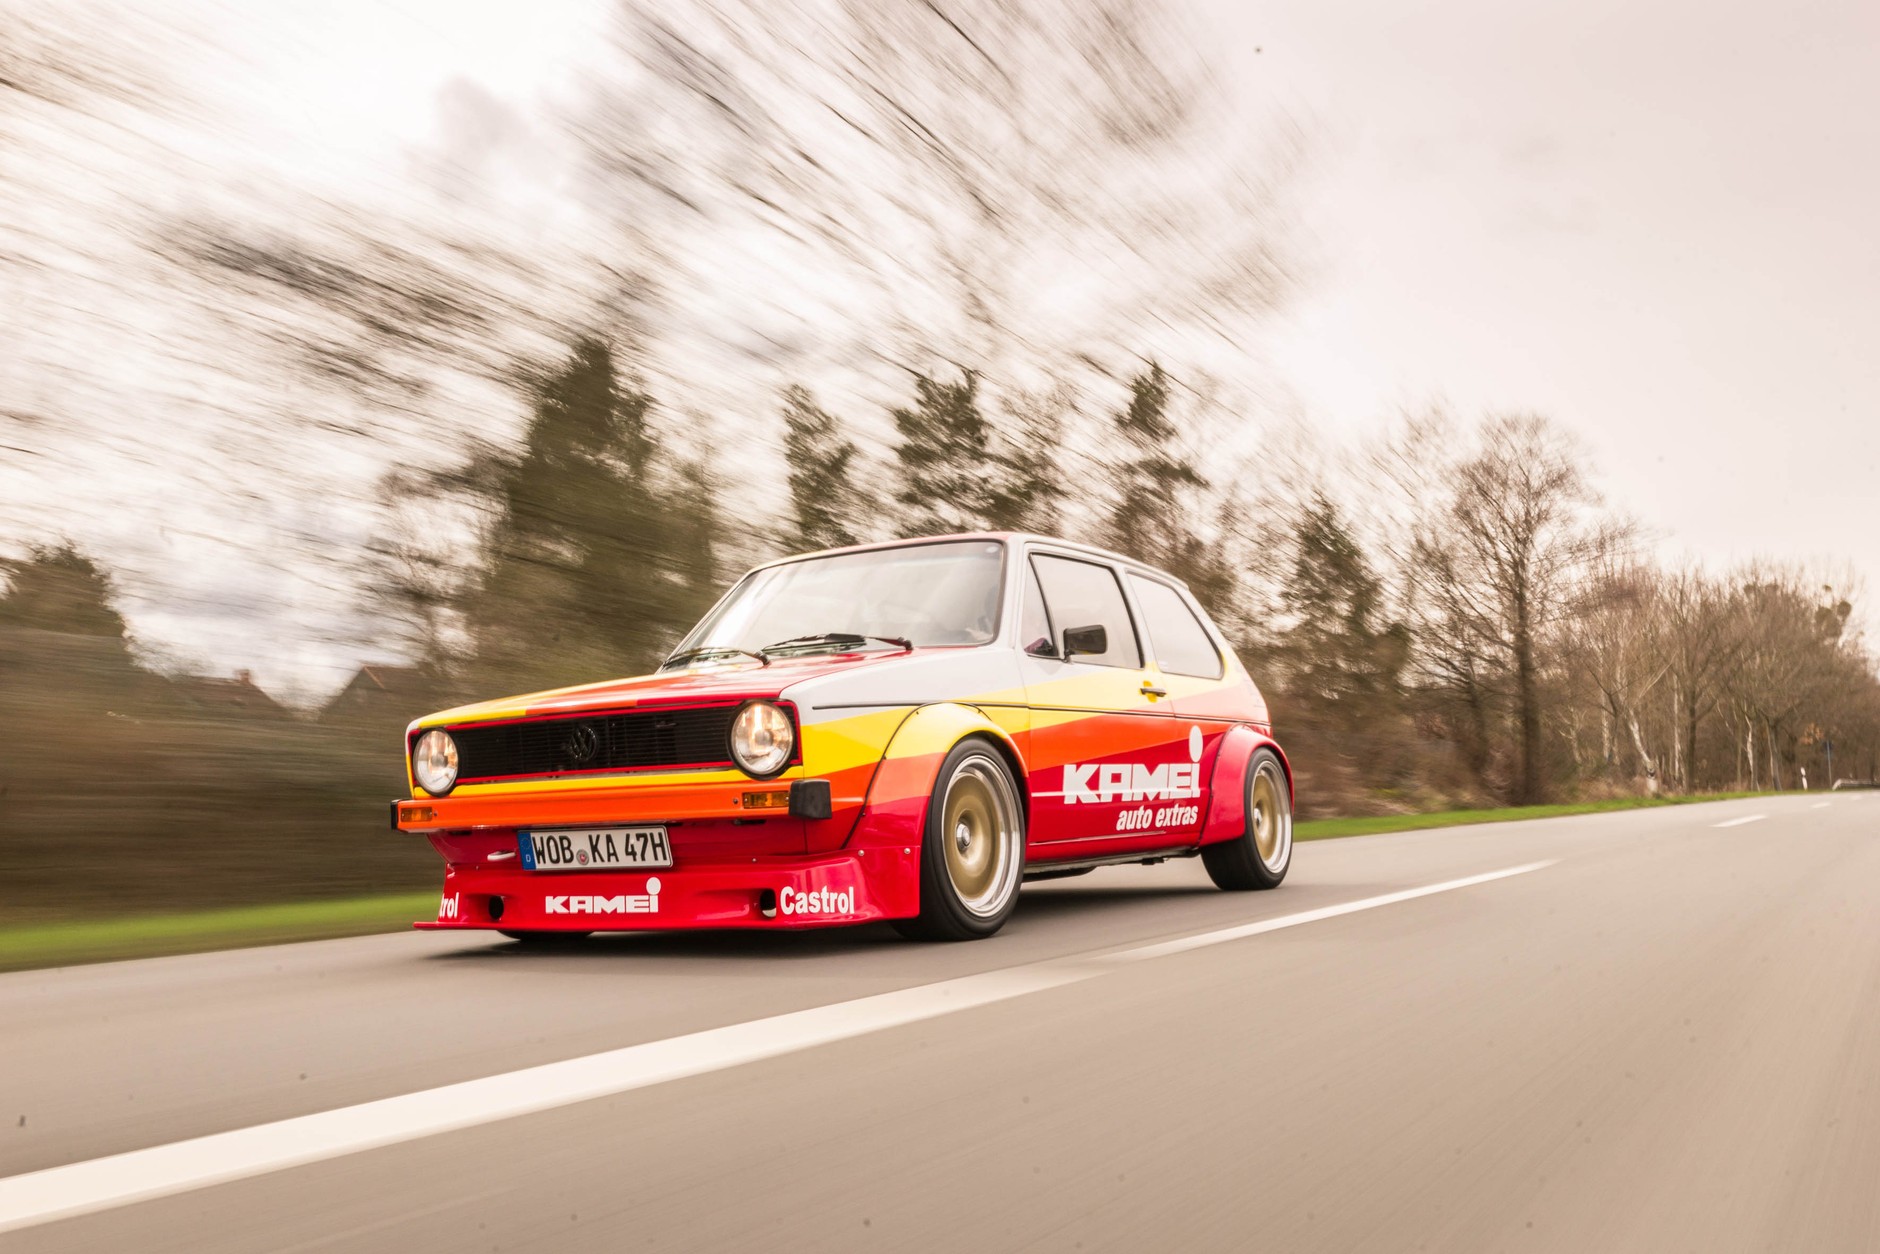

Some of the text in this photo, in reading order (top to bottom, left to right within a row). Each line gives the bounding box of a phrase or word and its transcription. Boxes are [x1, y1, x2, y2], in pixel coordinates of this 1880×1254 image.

[1116, 805, 1198, 831] auto extras
[532, 831, 667, 864] WOB KA 47H
[780, 885, 855, 915] Castrol
